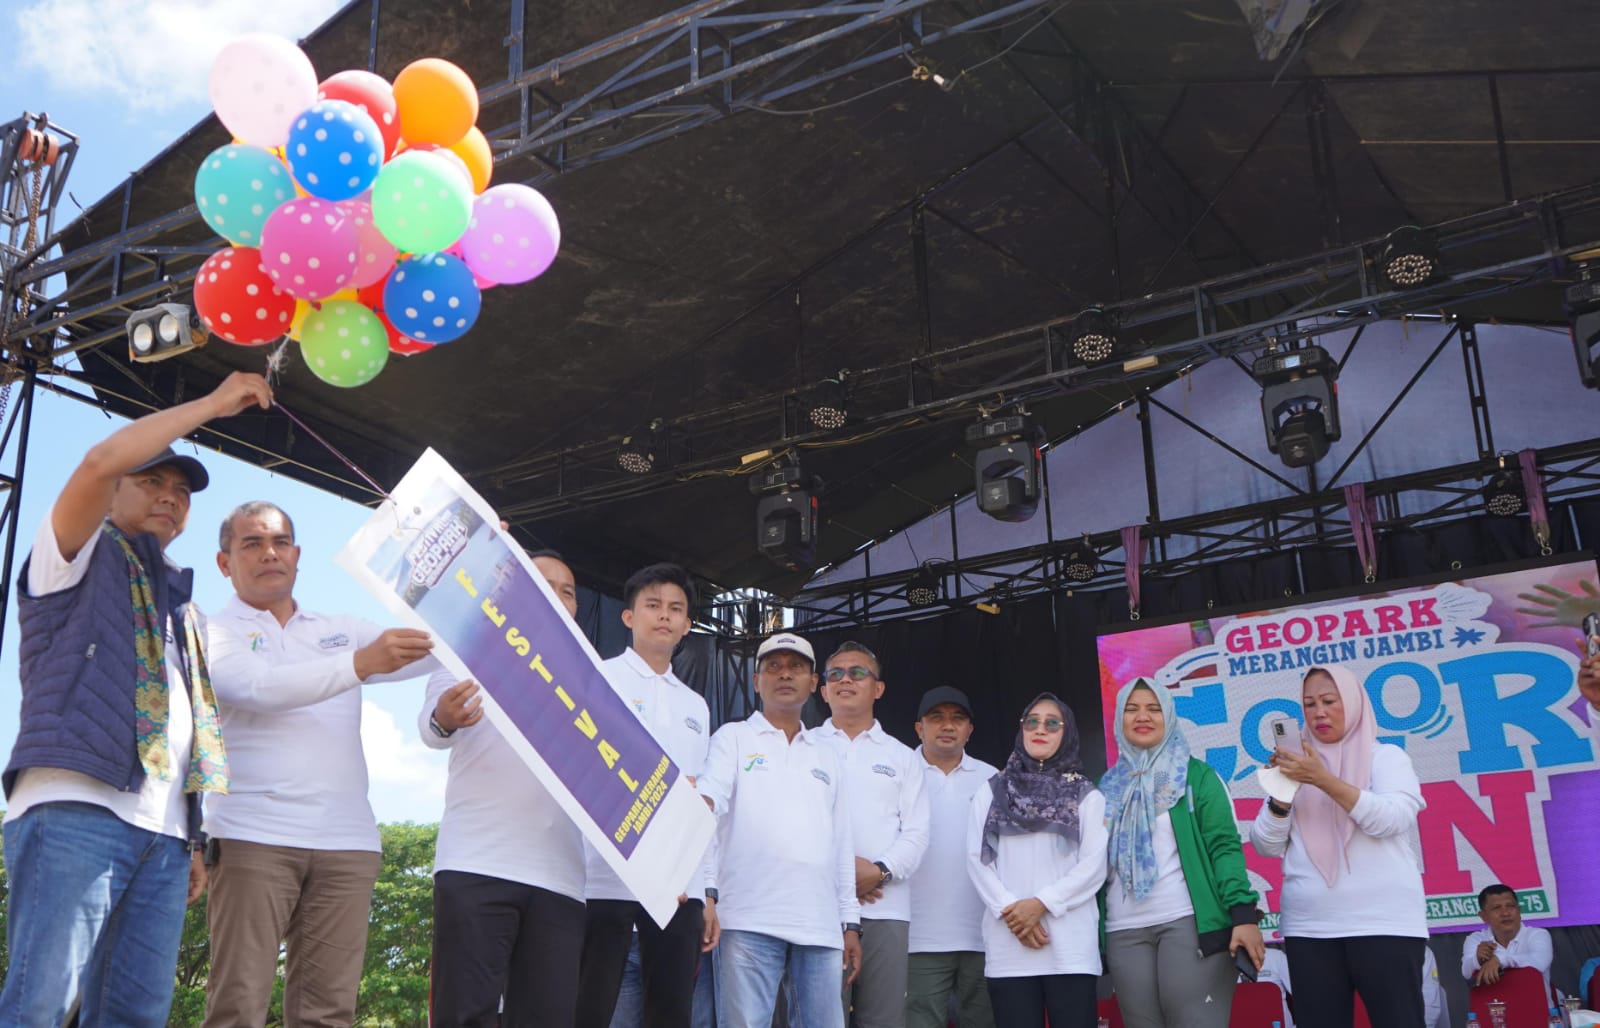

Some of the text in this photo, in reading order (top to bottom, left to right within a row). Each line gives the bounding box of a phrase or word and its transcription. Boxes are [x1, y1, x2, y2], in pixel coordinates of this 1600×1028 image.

[411, 520, 467, 584] GEOPARK
[1225, 597, 1442, 653] GEOPARK
[1228, 629, 1445, 676] MERANGIN JAMBI
[455, 567, 640, 793] FESTIVAL
[614, 754, 670, 843] GEOPARK MERANGIN
[632, 780, 668, 835] JAMBI 2024
